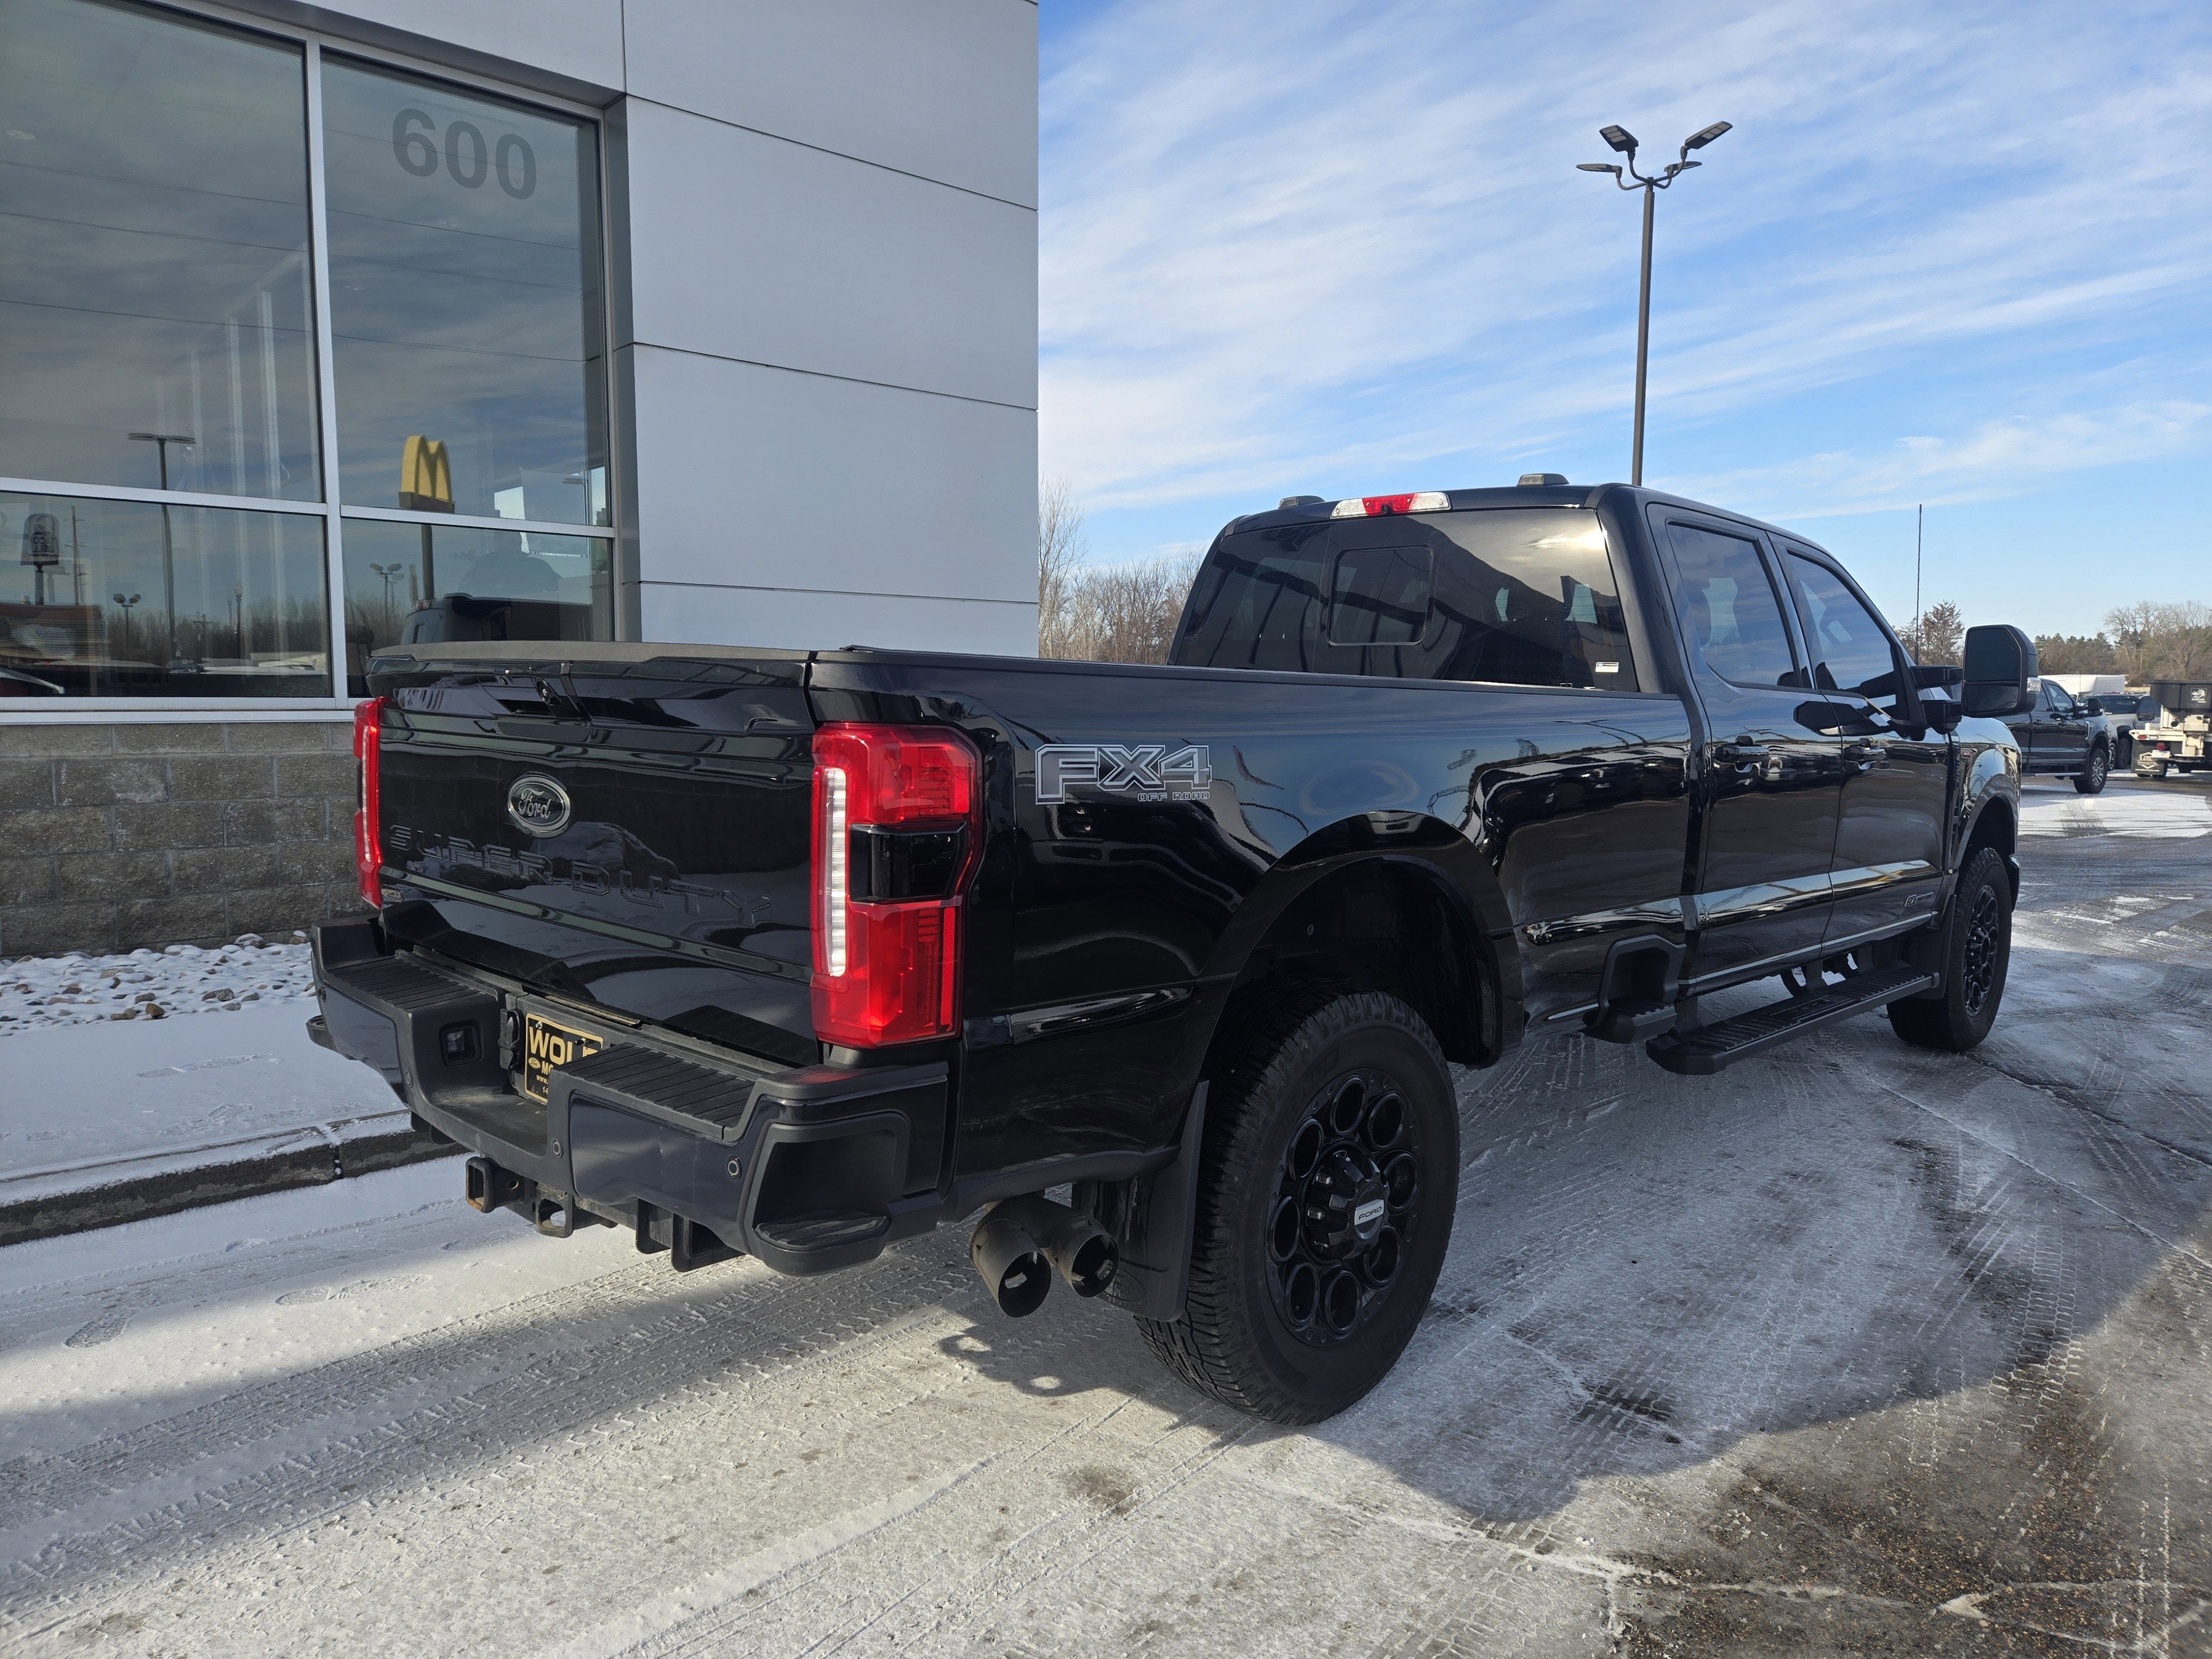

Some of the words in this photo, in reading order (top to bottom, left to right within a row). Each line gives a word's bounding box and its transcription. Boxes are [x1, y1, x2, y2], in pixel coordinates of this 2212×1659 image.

[392, 108, 537, 200] 600
[1035, 743, 1212, 805] FX4
[1137, 792, 1168, 801] OFF
[1172, 791, 1211, 801] ROAD
[518, 787, 552, 819] Ford
[389, 824, 554, 885] SUPER
[571, 860, 771, 928] DUTY
[1358, 1206, 1382, 1220] FORD
